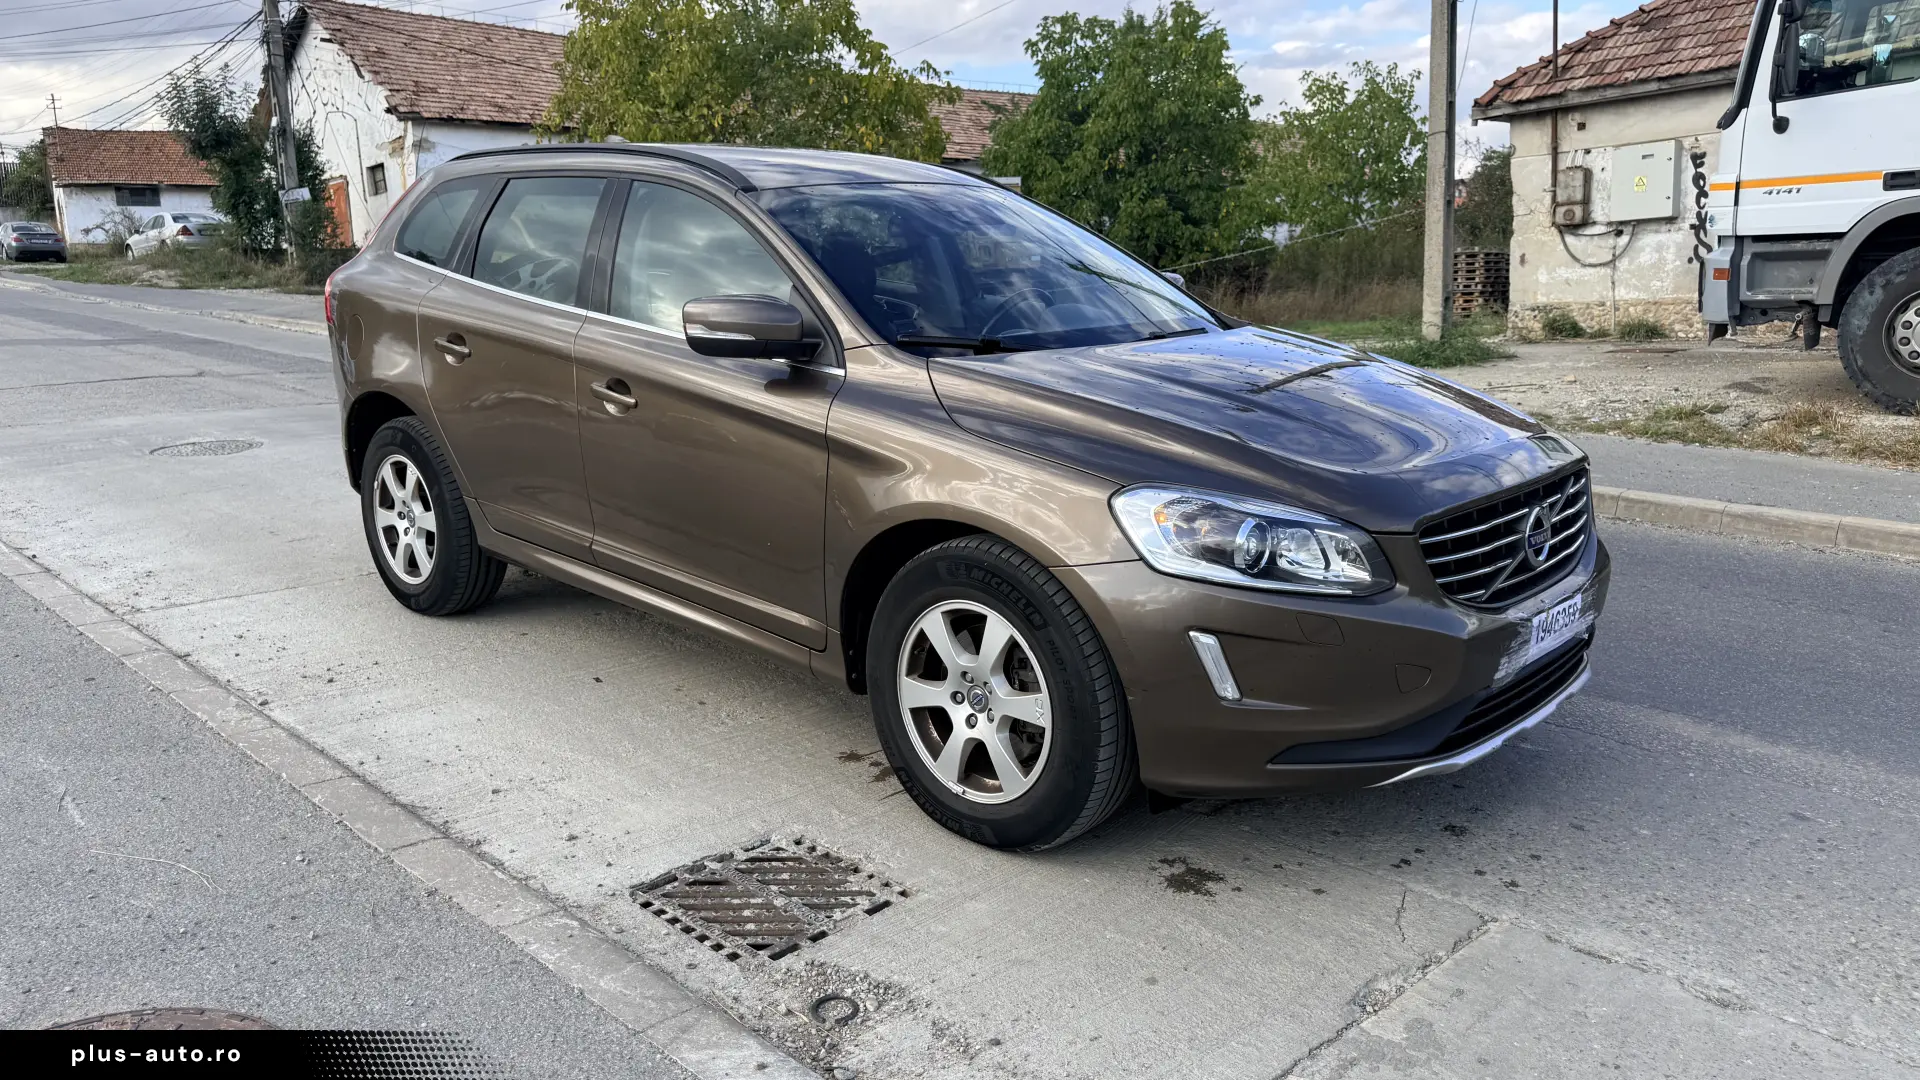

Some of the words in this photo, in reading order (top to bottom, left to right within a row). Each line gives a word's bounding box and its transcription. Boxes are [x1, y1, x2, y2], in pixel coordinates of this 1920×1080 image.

[1762, 186, 1803, 196] 4141
[970, 566, 1045, 628] MICHELIN
[1046, 639, 1067, 673] PILOT
